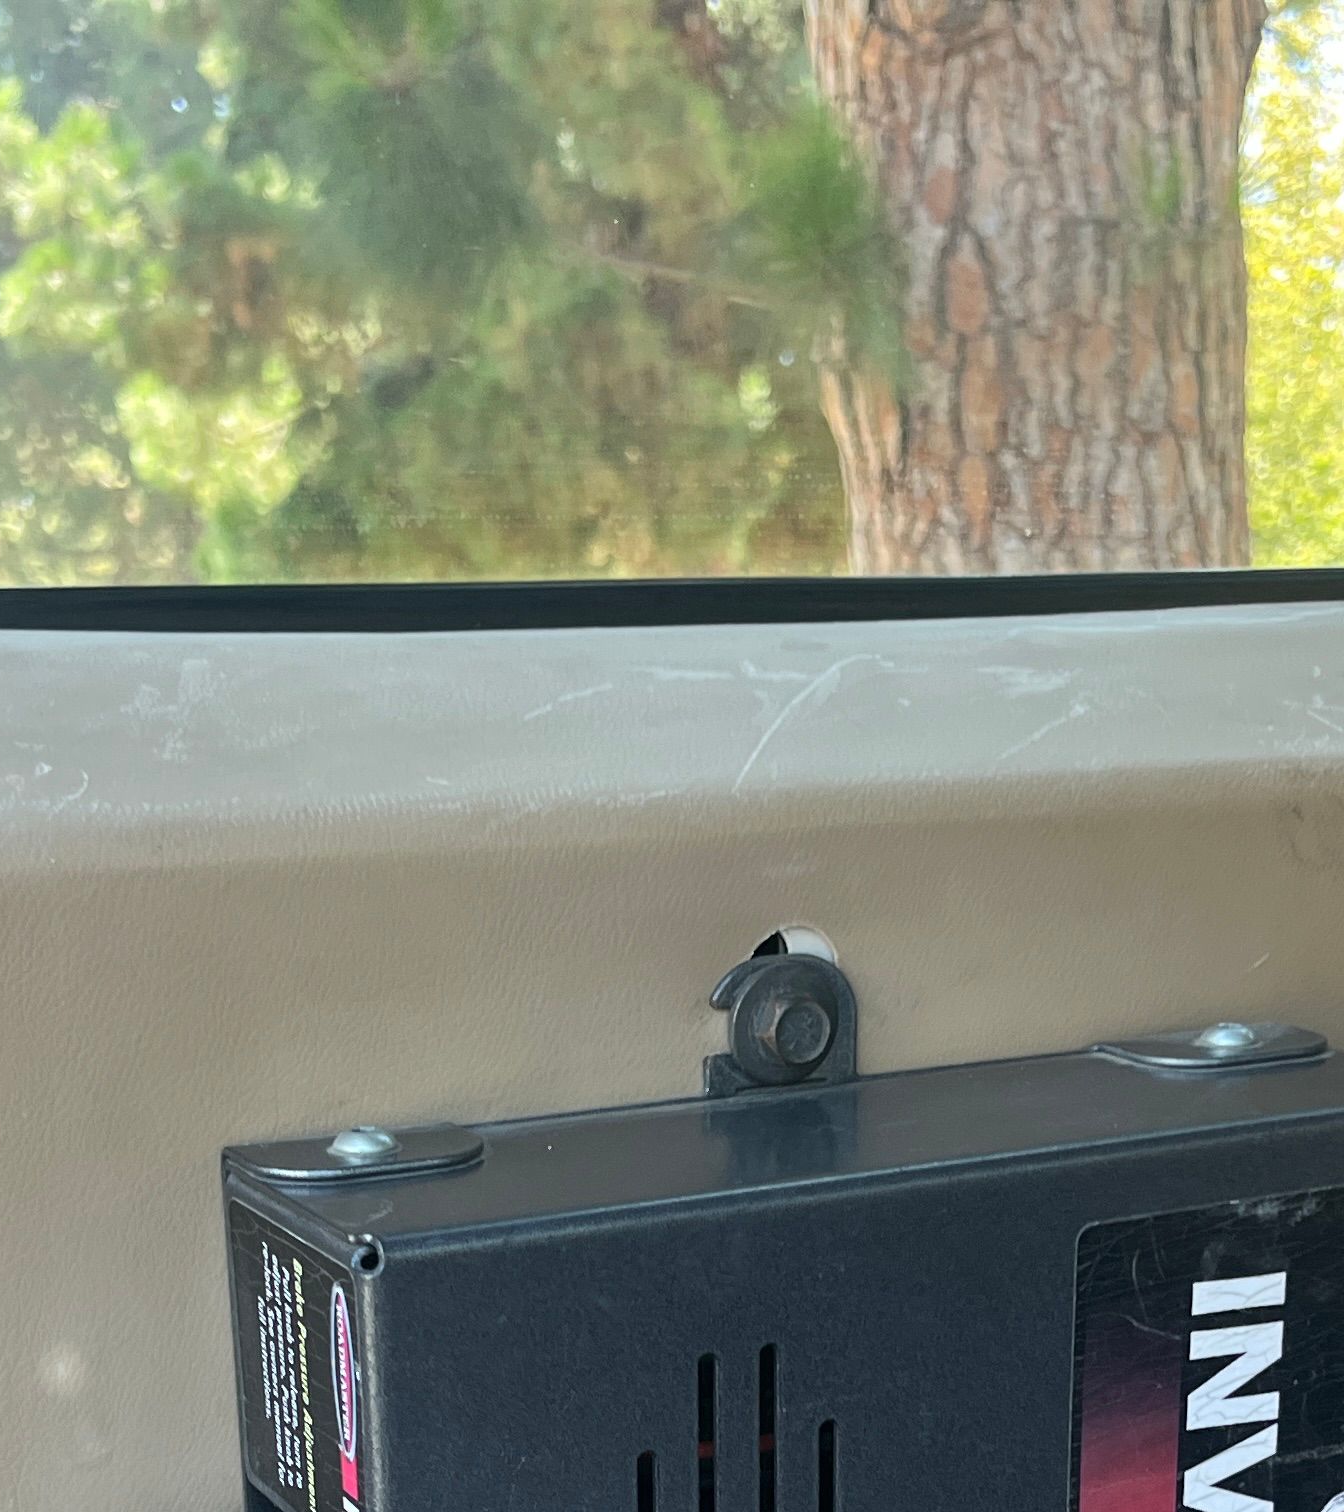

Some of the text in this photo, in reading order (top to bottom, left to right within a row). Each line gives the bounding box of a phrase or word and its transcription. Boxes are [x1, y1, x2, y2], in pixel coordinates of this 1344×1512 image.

[267, 1306, 275, 1337] See
[293, 1257, 305, 1317] Brake
[258, 1295, 272, 1419] full instructions.
[270, 1340, 279, 1398] owners
[272, 1254, 294, 1487] adjust pressure. Push knob to
[281, 1266, 303, 1489] Pull knob to release, turn to
[297, 1320, 309, 1405] Pressure
[335, 1303, 351, 1441] ROADMASTER
[273, 1400, 285, 1462] manual
[278, 1462, 286, 1487] for
